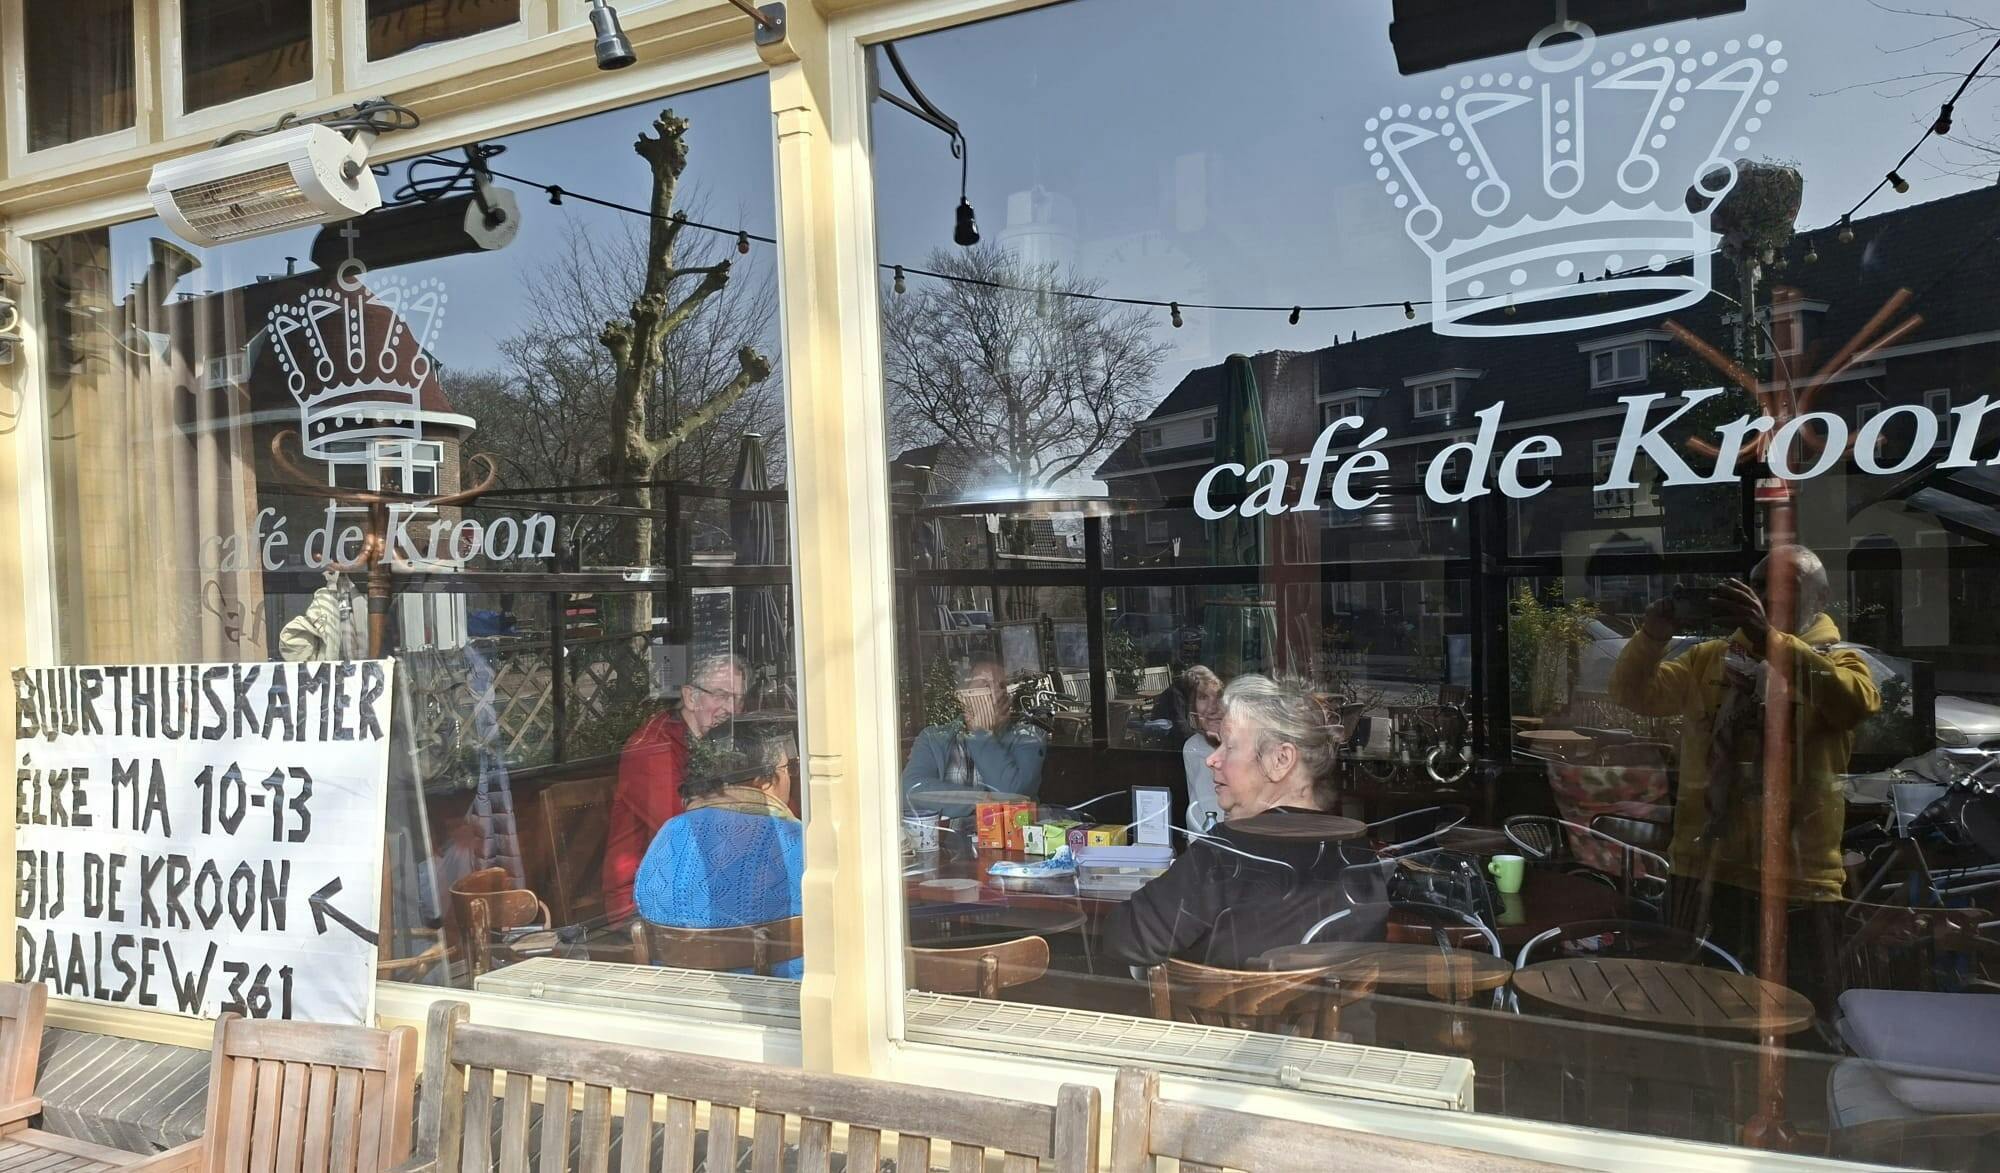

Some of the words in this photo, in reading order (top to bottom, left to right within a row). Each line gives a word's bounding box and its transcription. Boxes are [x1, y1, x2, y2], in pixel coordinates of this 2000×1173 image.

[1192, 416, 1389, 521] café
[1424, 402, 1563, 505] de
[1593, 386, 2000, 492] Kroon
[199, 506, 289, 573] café
[303, 498, 364, 569] de
[378, 500, 556, 564] Kroon
[12, 663, 385, 742] BUURTHUISKAMER
[111, 757, 172, 838] MA
[194, 761, 313, 842] 10-13
[15, 850, 65, 920] BIJ
[83, 852, 127, 922] DE
[140, 854, 291, 932] KROON
[221, 960, 294, 1020] 361
